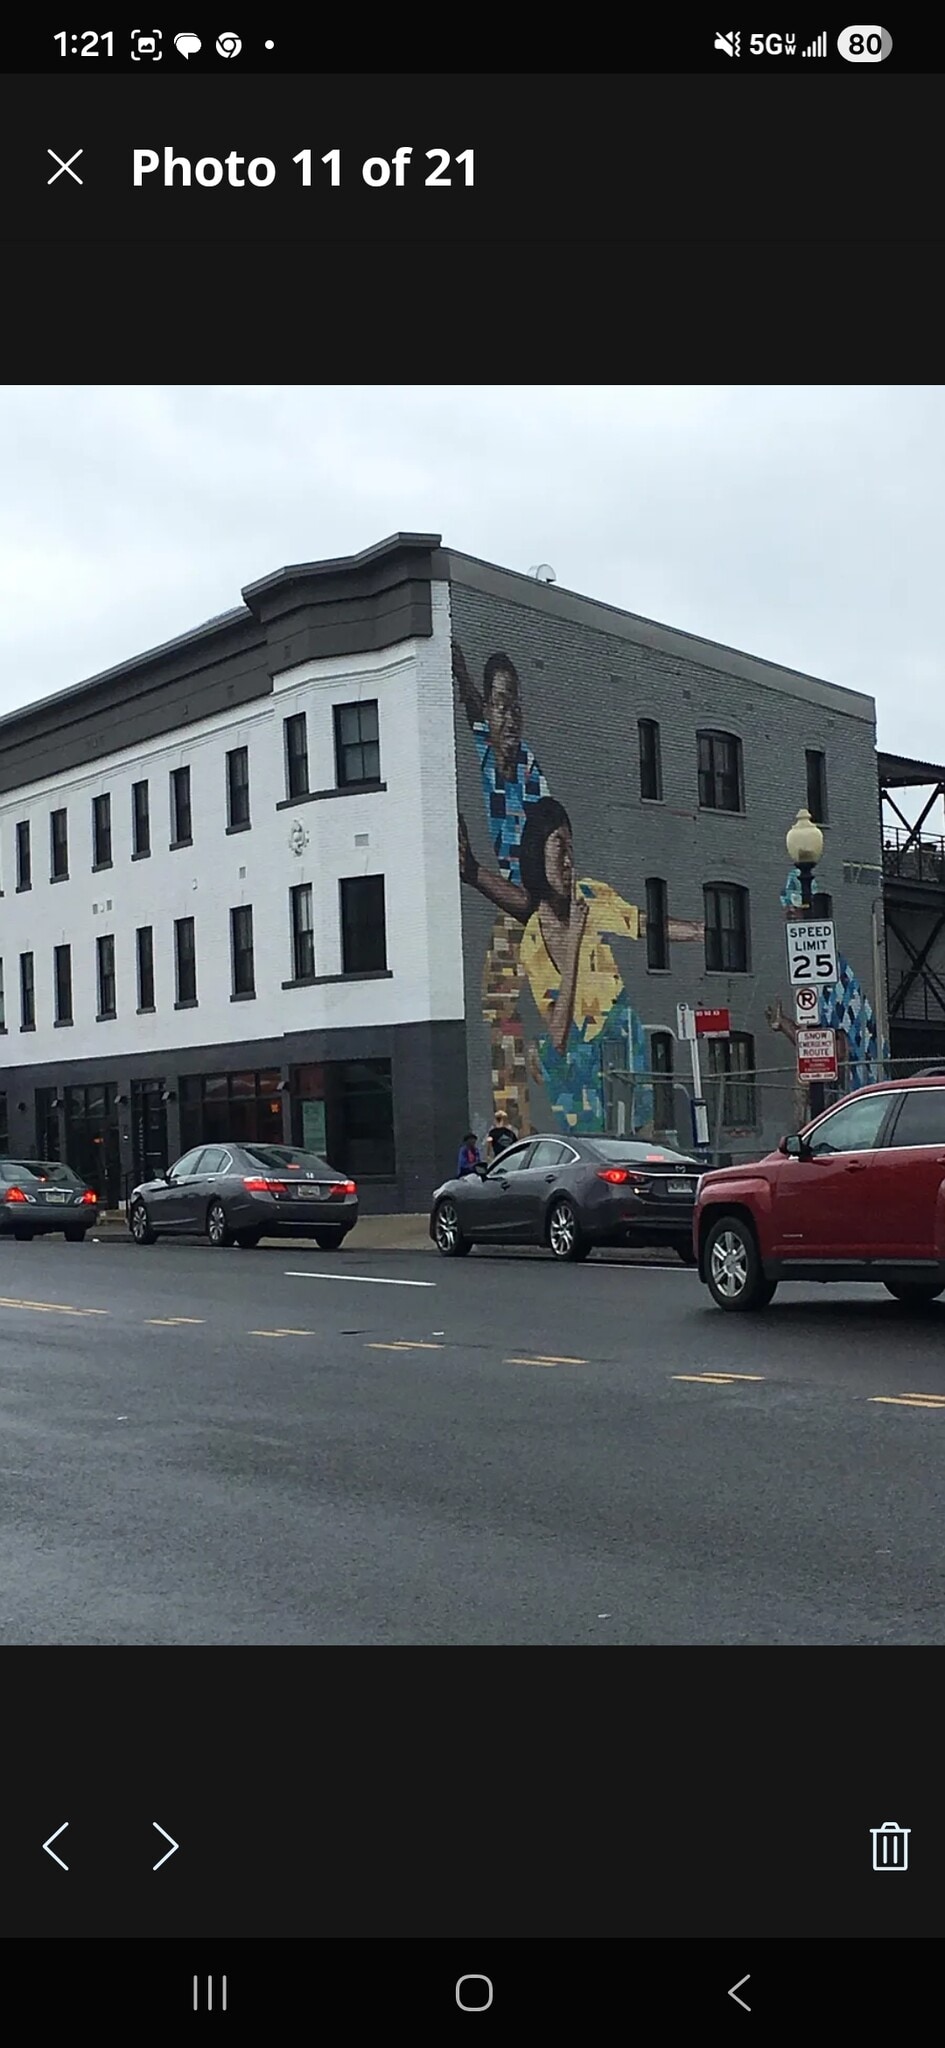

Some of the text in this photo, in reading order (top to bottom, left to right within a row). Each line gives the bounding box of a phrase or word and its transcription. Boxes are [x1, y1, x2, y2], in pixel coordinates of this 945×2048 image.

[789, 926, 832, 938] SPEED
[795, 940, 828, 951] LIMIT
[793, 954, 833, 978] 25
[804, 1032, 827, 1040] SNOW
